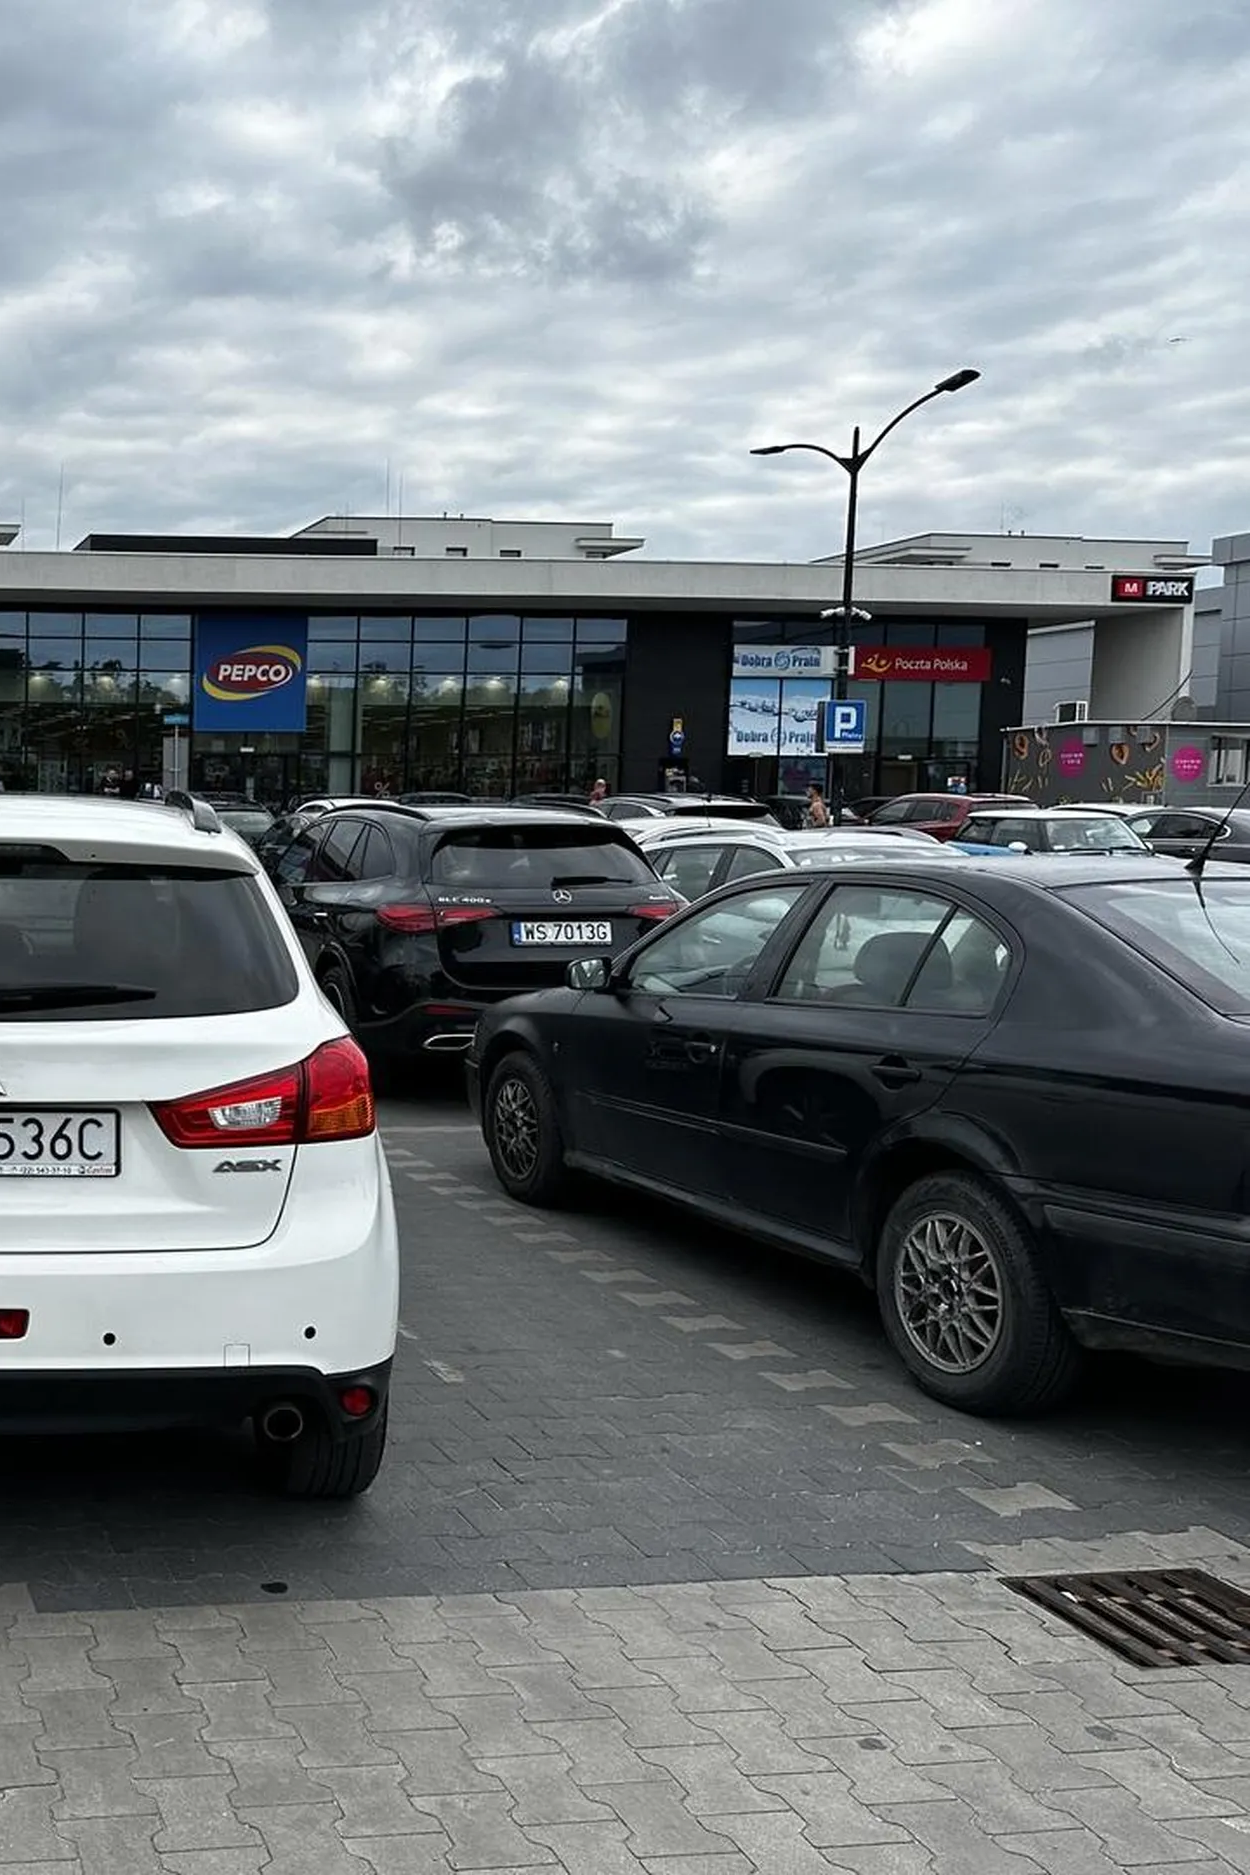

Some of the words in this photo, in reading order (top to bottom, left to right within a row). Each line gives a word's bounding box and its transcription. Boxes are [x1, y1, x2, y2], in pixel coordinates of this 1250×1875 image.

[1124, 582, 1138, 593] M
[1146, 581, 1189, 596] PARK
[741, 653, 772, 668] Dobra
[895, 657, 931, 671] Poczta
[933, 658, 968, 671] Polska
[218, 664, 286, 682] PEPCO
[834, 706, 857, 738] P
[736, 731, 768, 743] Dobra
[524, 922, 547, 940] WS
[553, 923, 608, 940] 7013G
[213, 1159, 282, 1173] ASX
